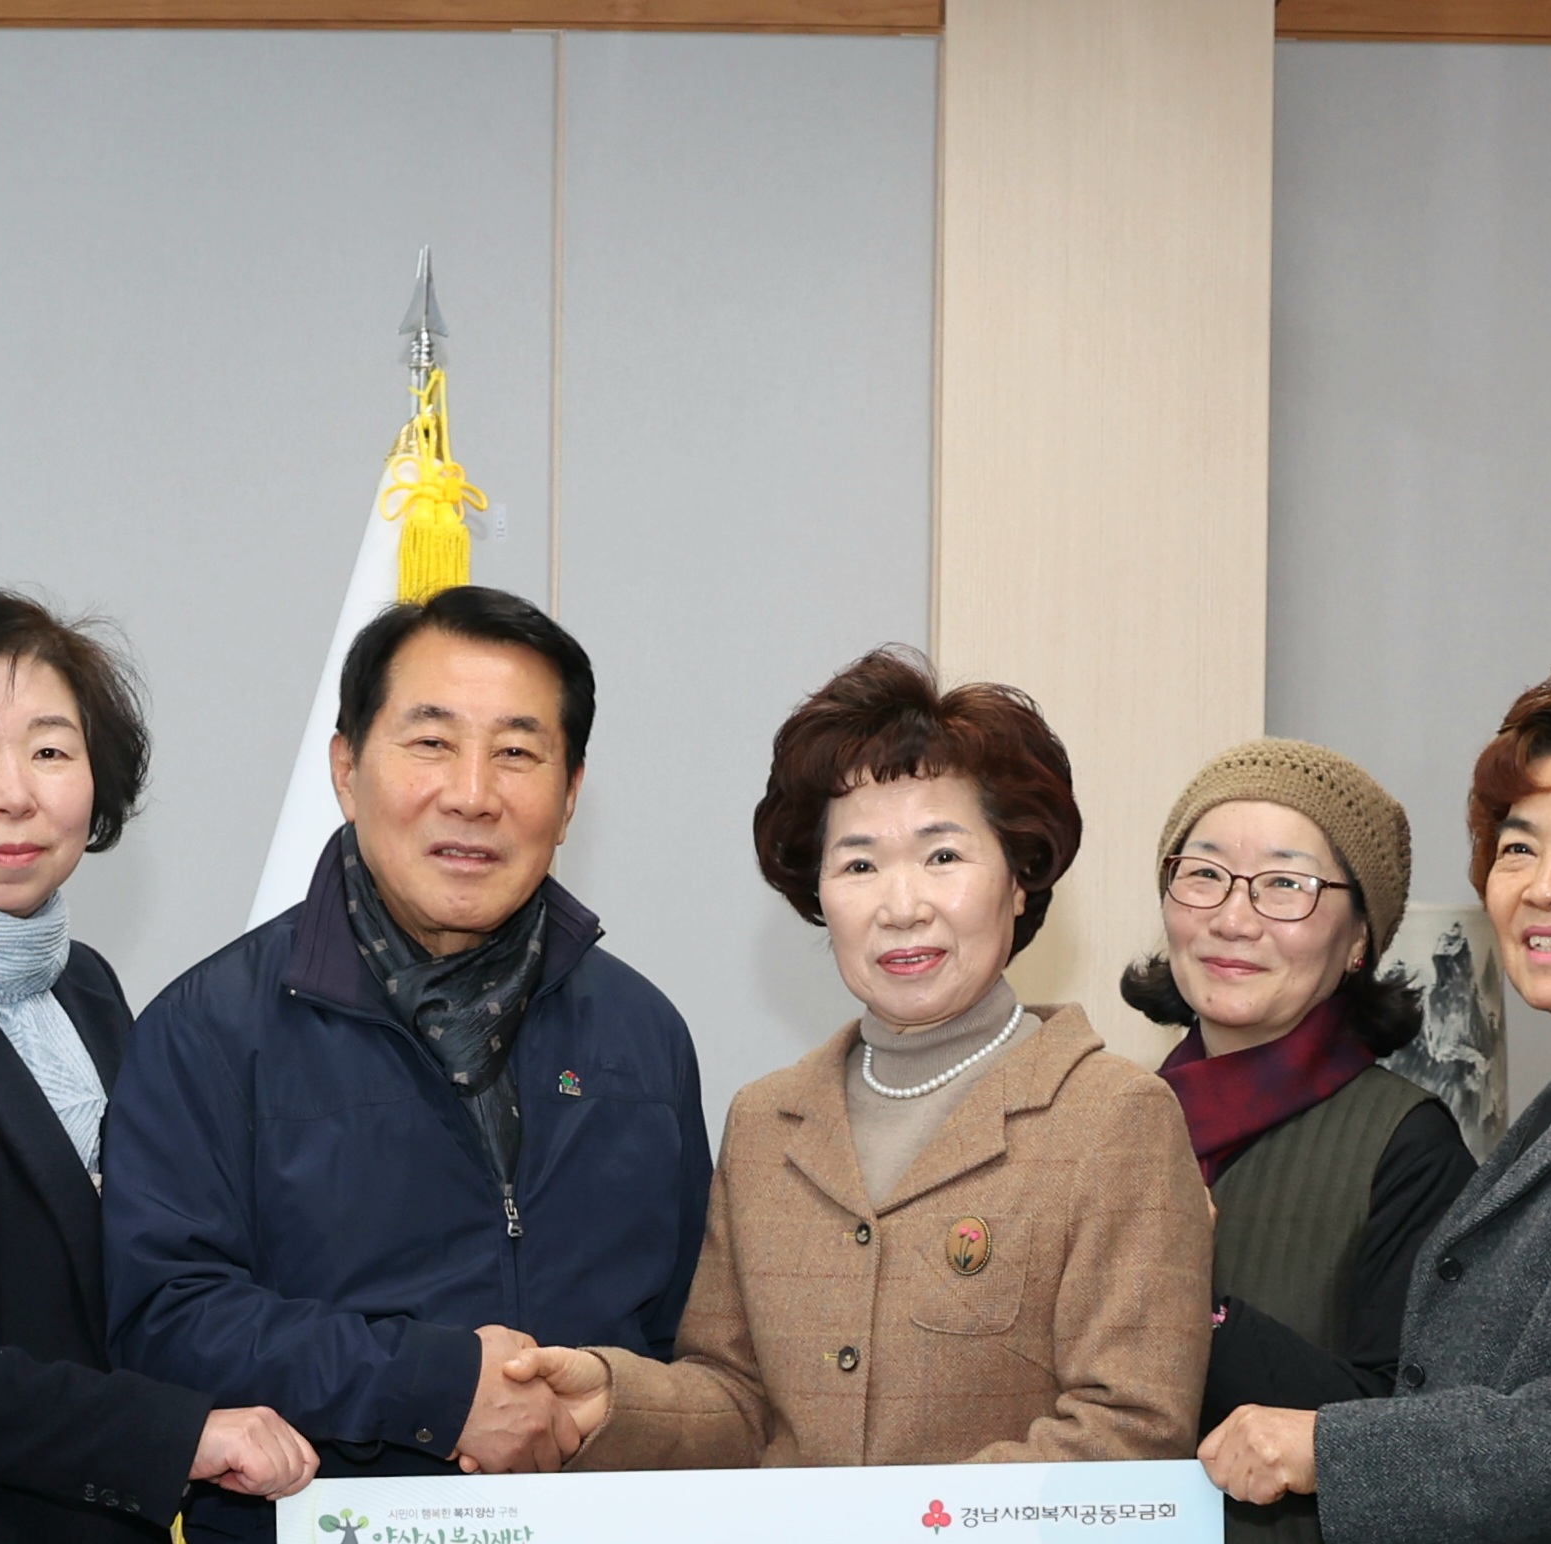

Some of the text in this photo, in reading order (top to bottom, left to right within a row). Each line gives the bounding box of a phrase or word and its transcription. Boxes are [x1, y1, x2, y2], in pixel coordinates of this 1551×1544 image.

[388, 1507, 518, 1520] 시민이 행복한 복지 양산 구현
[960, 1503, 1177, 1528] 경남사회복지공동모금회
